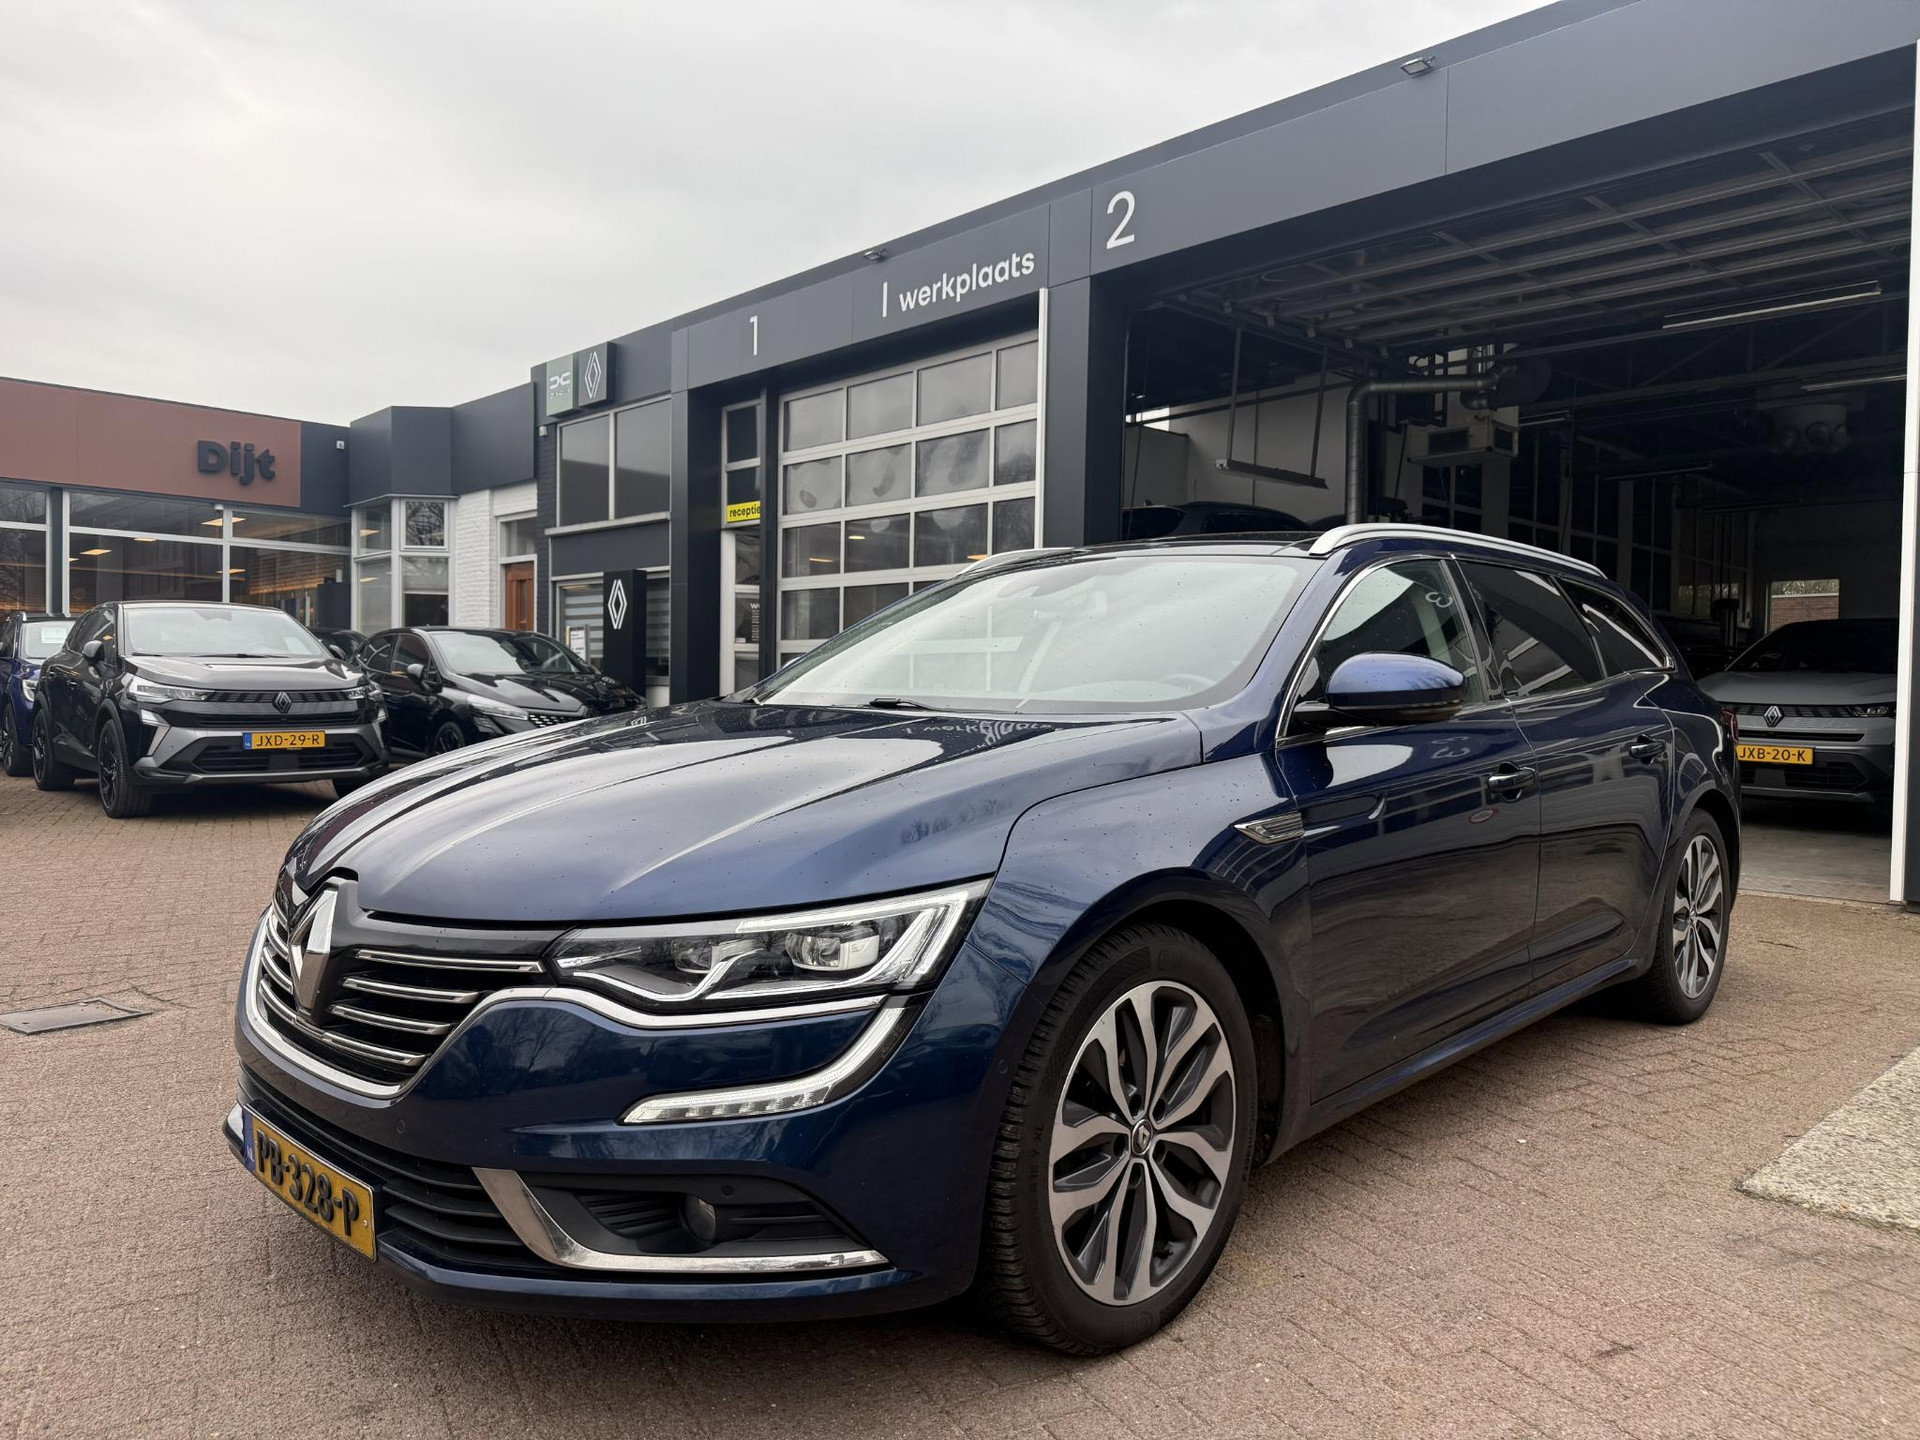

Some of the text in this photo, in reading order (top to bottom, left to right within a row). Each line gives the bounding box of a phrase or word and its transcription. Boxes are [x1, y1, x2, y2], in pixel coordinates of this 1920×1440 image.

[1107, 190, 1135, 249] 2
[899, 252, 1035, 312] werkplaats
[750, 315, 757, 355] 1
[198, 440, 276, 486] Dijt
[256, 733, 320, 747] JXD-29-R
[1739, 746, 1806, 762] JXB-20-K
[256, 1129, 360, 1237] PB-328-P
